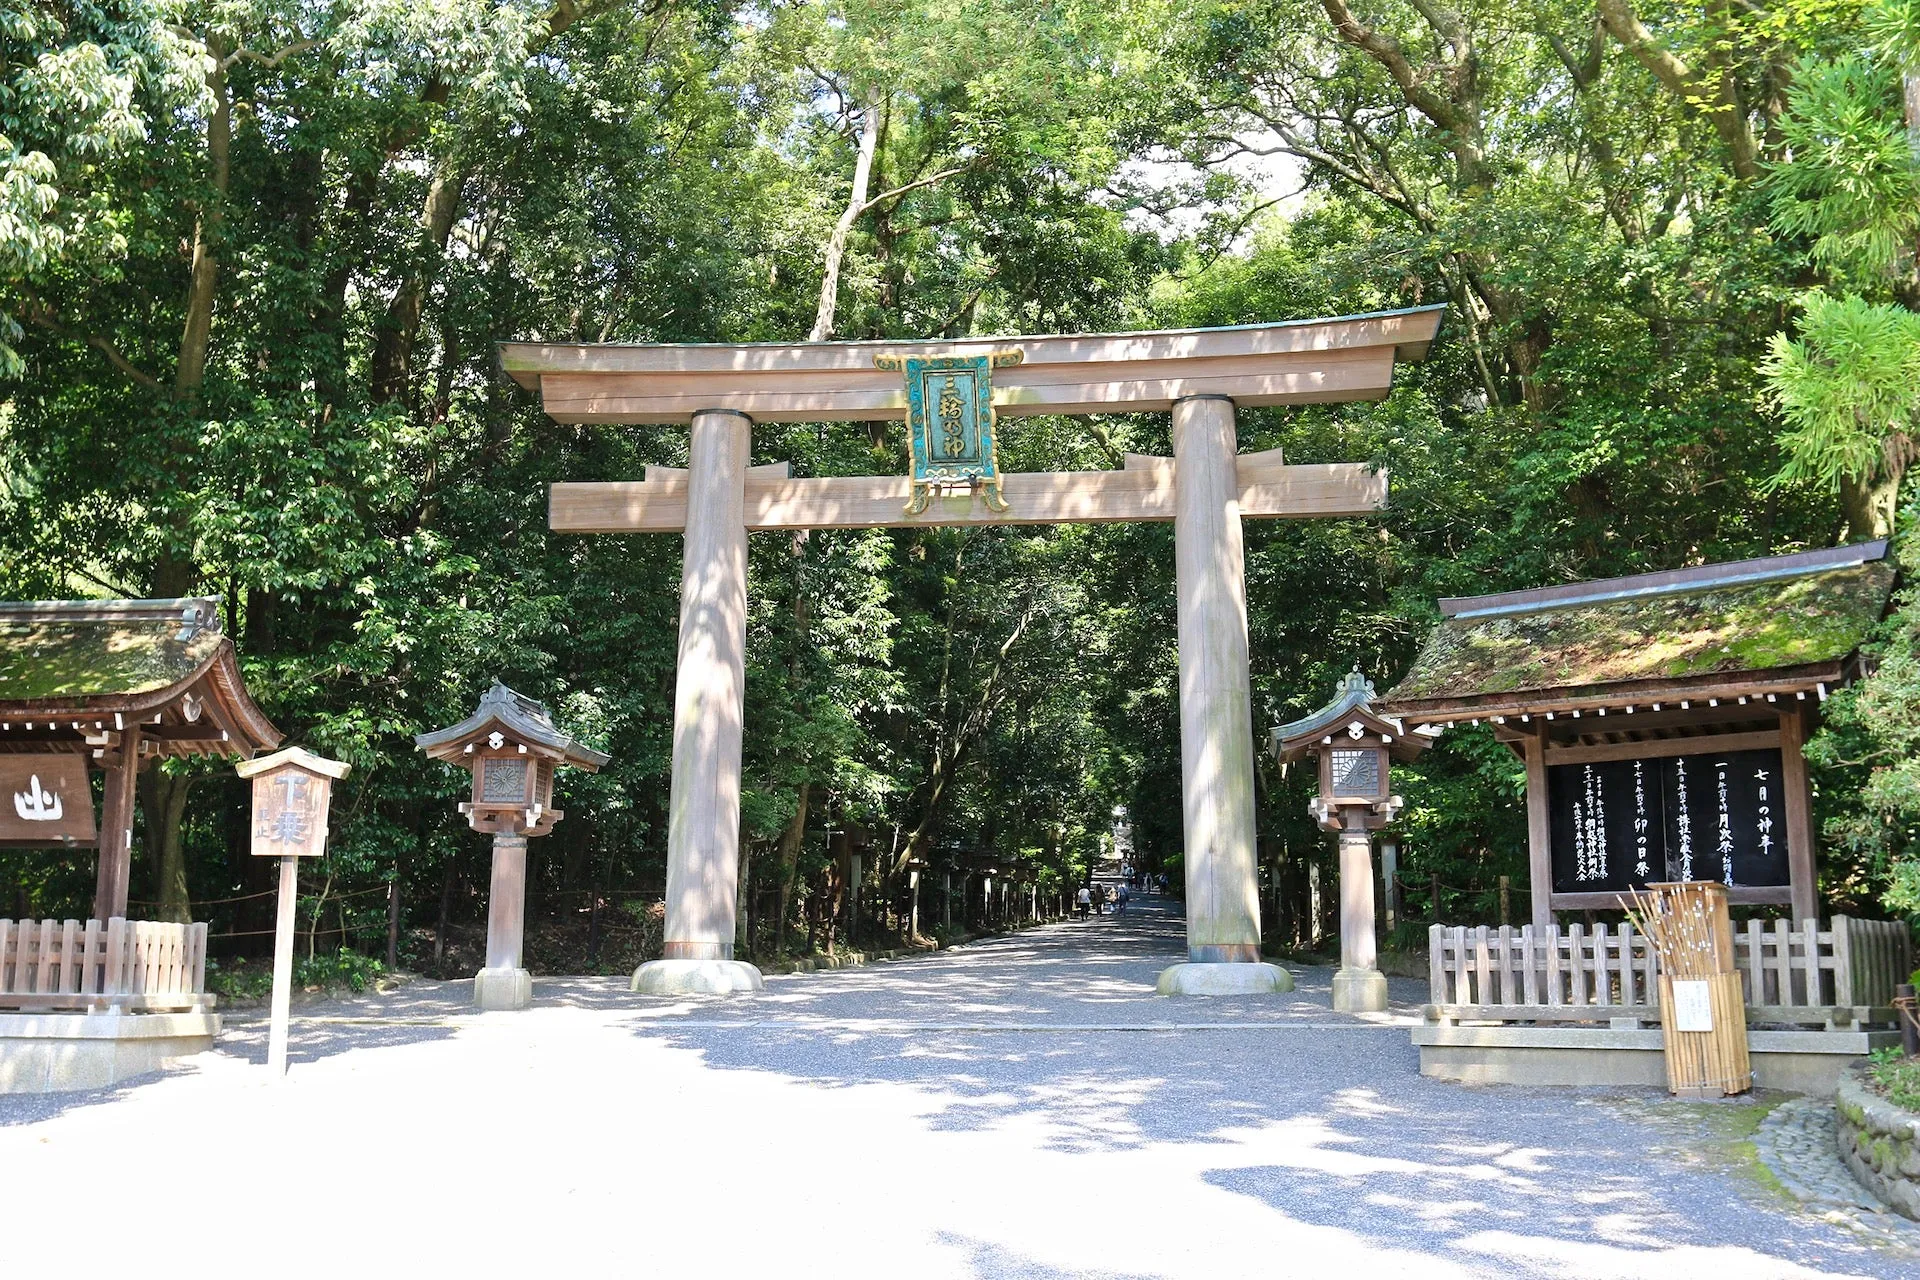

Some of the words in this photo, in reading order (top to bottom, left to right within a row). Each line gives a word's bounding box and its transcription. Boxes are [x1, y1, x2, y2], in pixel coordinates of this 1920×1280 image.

[1634, 761, 1650, 877] 十七日午前十時卯の日祭
[1754, 769, 1774, 855] 七月の神事
